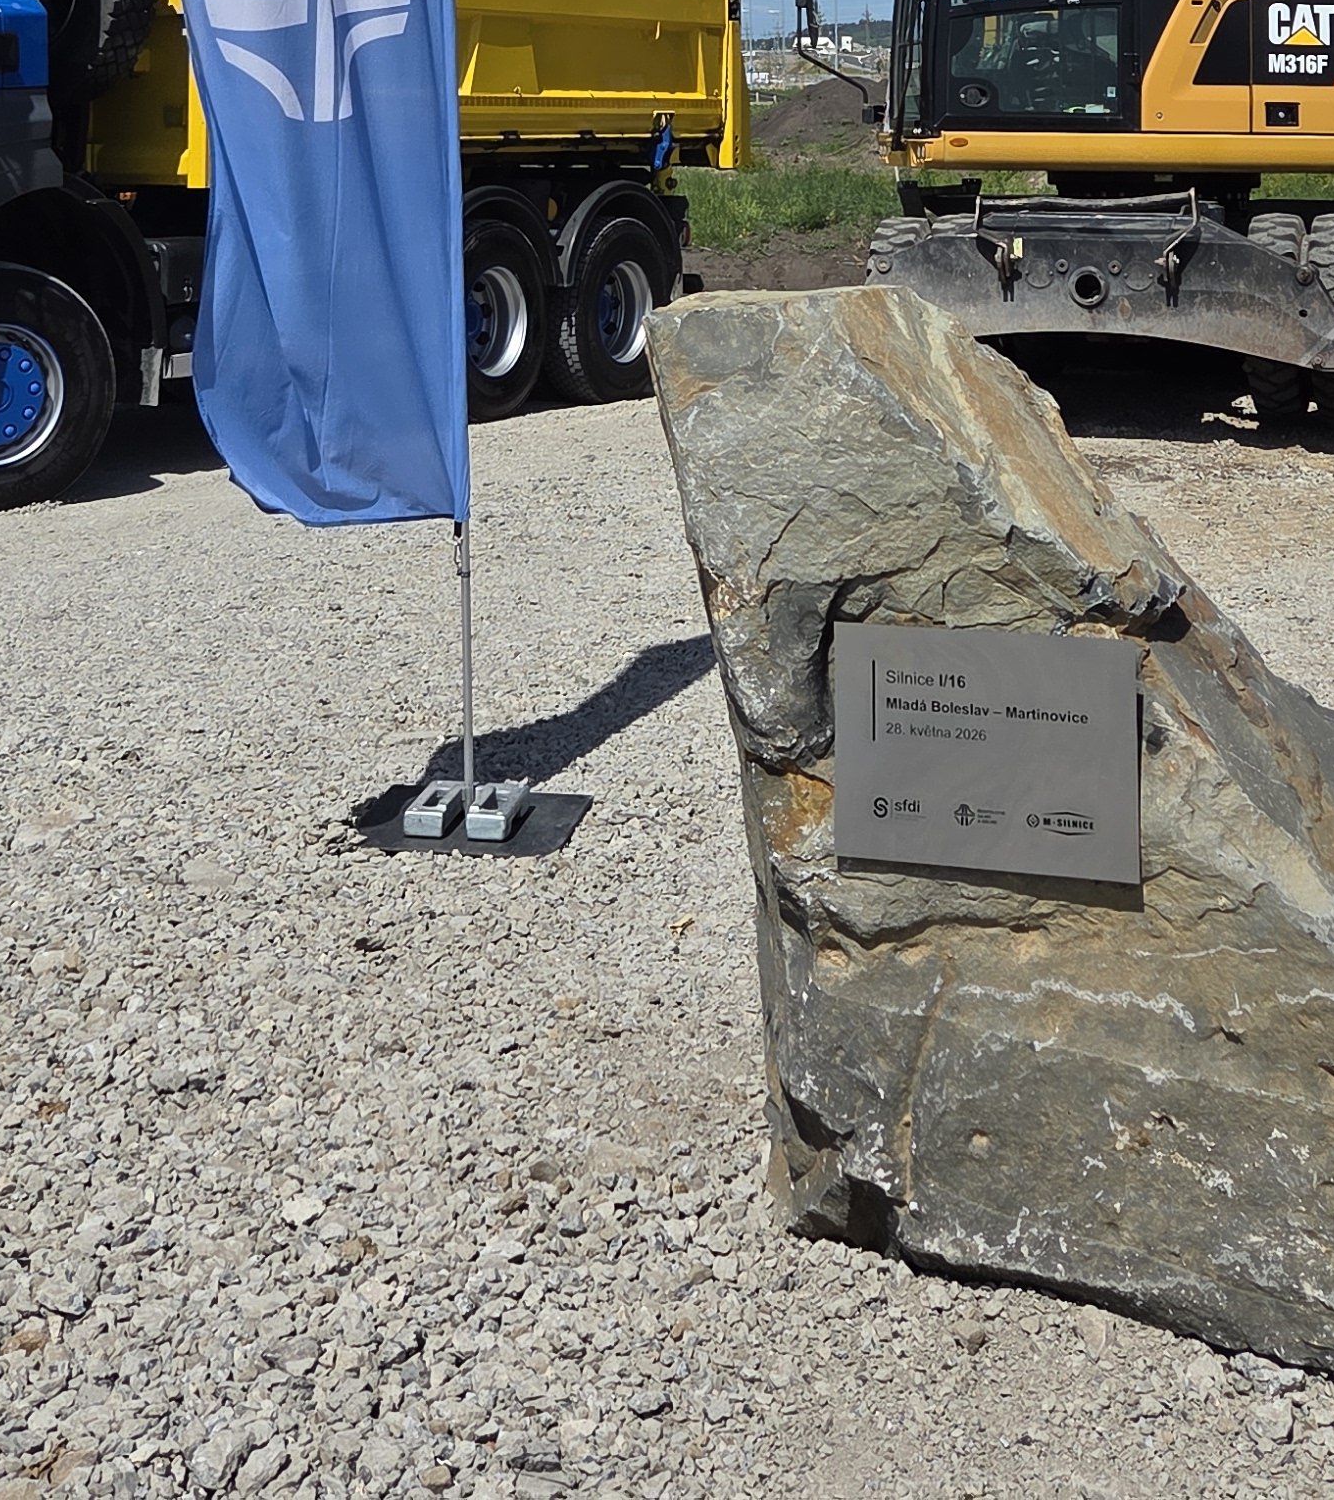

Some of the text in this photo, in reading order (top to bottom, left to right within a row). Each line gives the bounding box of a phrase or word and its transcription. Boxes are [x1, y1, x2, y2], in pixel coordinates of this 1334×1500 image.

[1268, 53, 1329, 75] M316F
[885, 669, 966, 689] Silnice I/16
[886, 697, 927, 712] Mladá
[931, 700, 990, 717] Boleslav
[1006, 706, 1089, 724] Martinovice
[885, 722, 987, 742] 28. května 2026
[894, 799, 920, 813] sfdi
